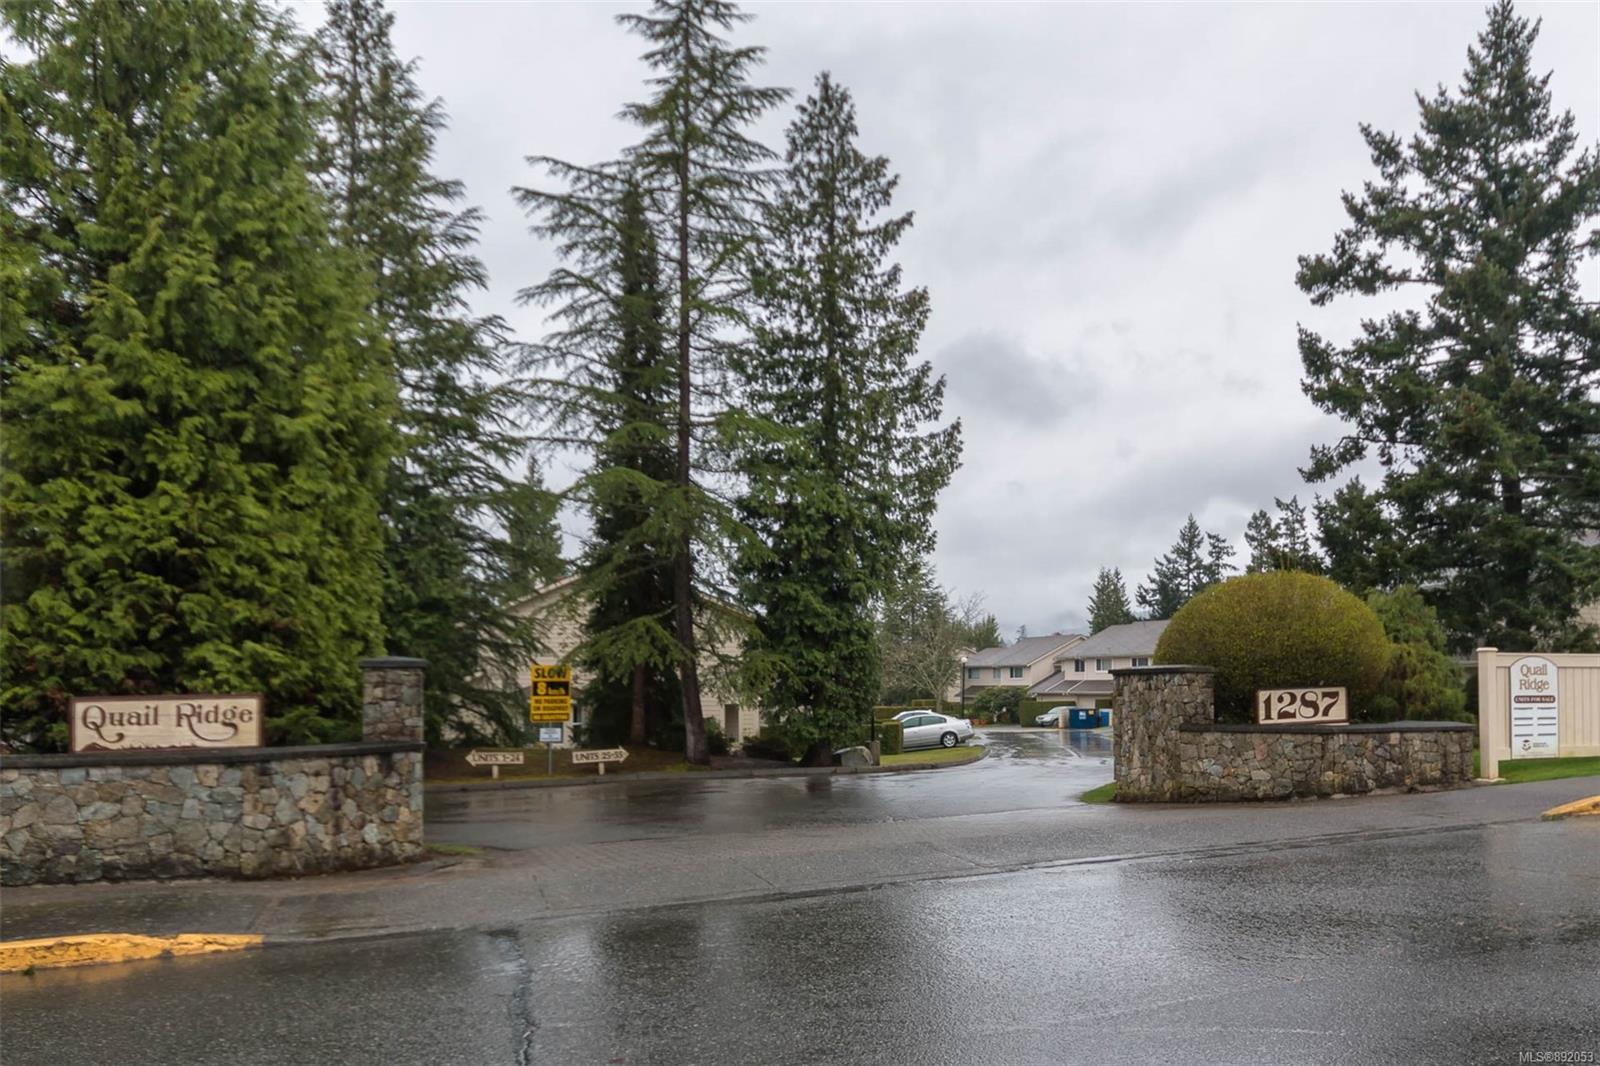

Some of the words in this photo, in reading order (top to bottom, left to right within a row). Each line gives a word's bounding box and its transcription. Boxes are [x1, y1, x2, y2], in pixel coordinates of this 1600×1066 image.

[535, 667, 566, 679] SLOW
[1520, 664, 1548, 678] Quail
[537, 681, 547, 695] 8
[1519, 679, 1550, 693] Ridge
[1262, 691, 1340, 720] 1287
[82, 704, 160, 744] Quail
[175, 703, 253, 742] Ridge
[575, 751, 600, 762] UNITS
